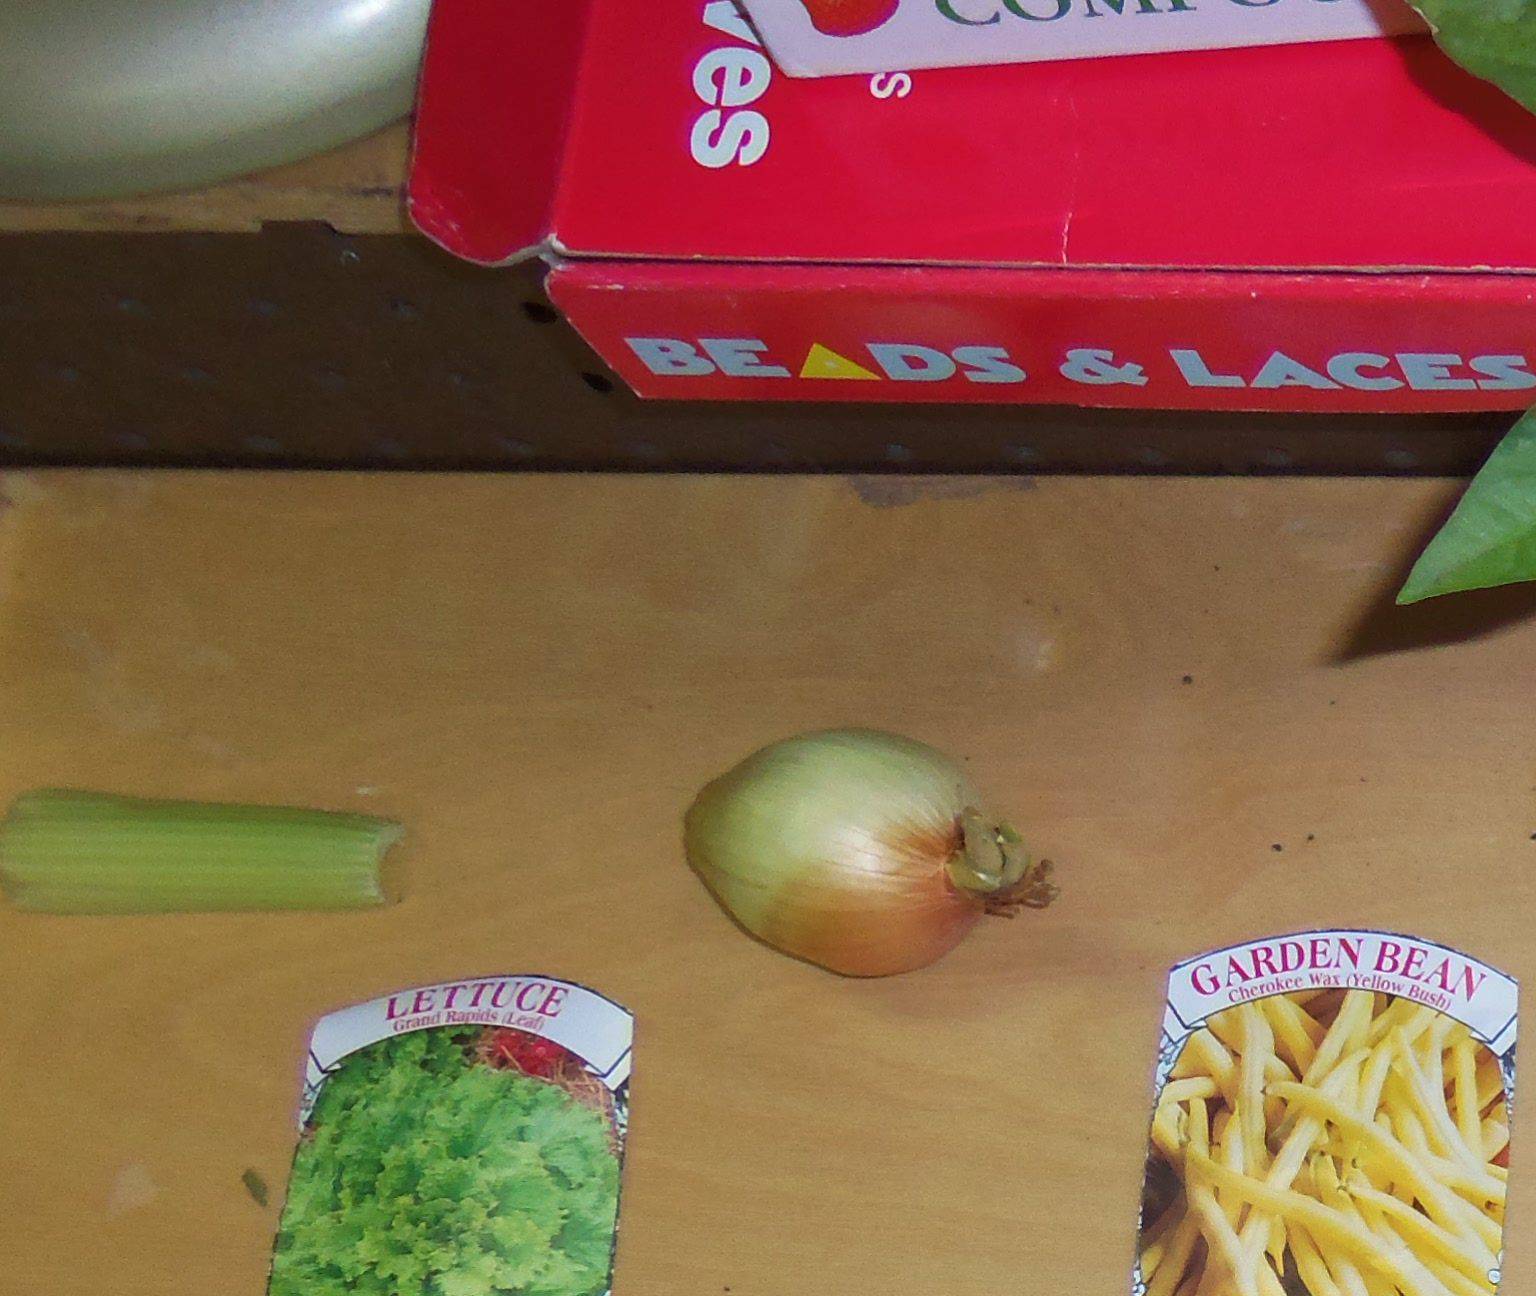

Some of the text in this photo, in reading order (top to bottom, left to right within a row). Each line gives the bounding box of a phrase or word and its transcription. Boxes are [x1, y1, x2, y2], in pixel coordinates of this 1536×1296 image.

[623, 337, 1026, 385] BEADS
[1059, 347, 1149, 387] &
[1190, 937, 1488, 1002] GARDEN BEAN
[385, 981, 569, 1021] LETTUCE
[1228, 972, 1452, 1011] Cherokee Wax (Yellow Bush)
[392, 1009, 546, 1033] Grand Rapids (Leaf)
